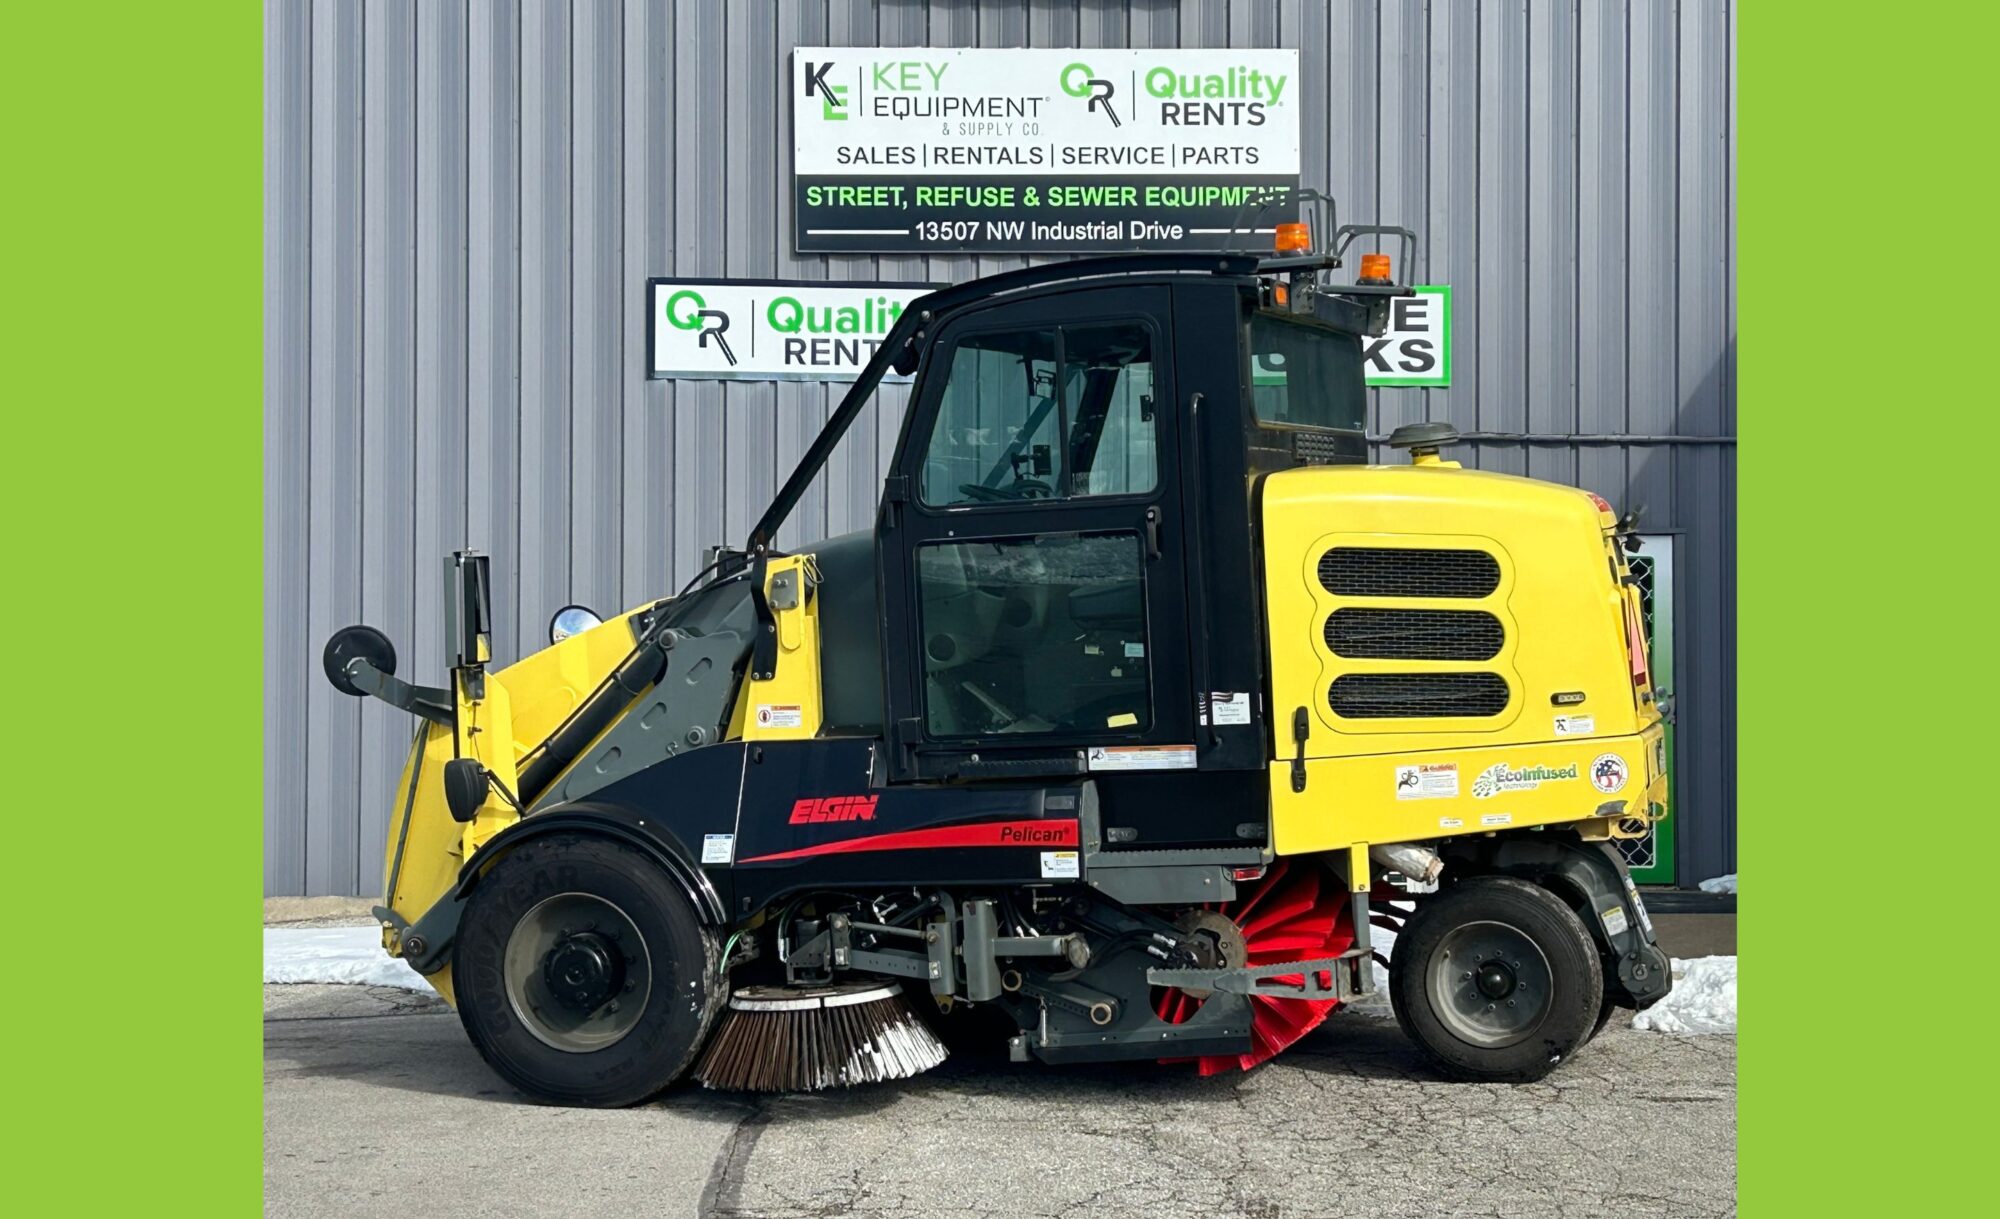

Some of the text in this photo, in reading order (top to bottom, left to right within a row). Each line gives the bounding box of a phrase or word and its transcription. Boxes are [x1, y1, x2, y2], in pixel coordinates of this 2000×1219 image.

[873, 62, 948, 91] KEY
[1145, 66, 1287, 106] Quality
[874, 97, 1043, 120] EQUIPMENT
[1060, 63, 1121, 128] QR
[1161, 102, 1266, 126] RENTS
[942, 122, 950, 136] &
[959, 122, 1013, 136] SUPPLY
[837, 146, 1259, 165] SALES RENTALS SERVICE PARTS
[807, 187, 907, 210] STREET,
[916, 187, 1015, 206] REFUSE
[1023, 187, 1040, 206] &
[1048, 187, 1137, 206] SEWER
[915, 220, 1183, 240] 13507 NW Industrial Drive
[666, 290, 737, 366] QR
[767, 296, 903, 334] Qualit
[785, 338, 885, 366] RENT
[1496, 764, 1577, 782] EcoInfused
[788, 795, 879, 824] ELGIN
